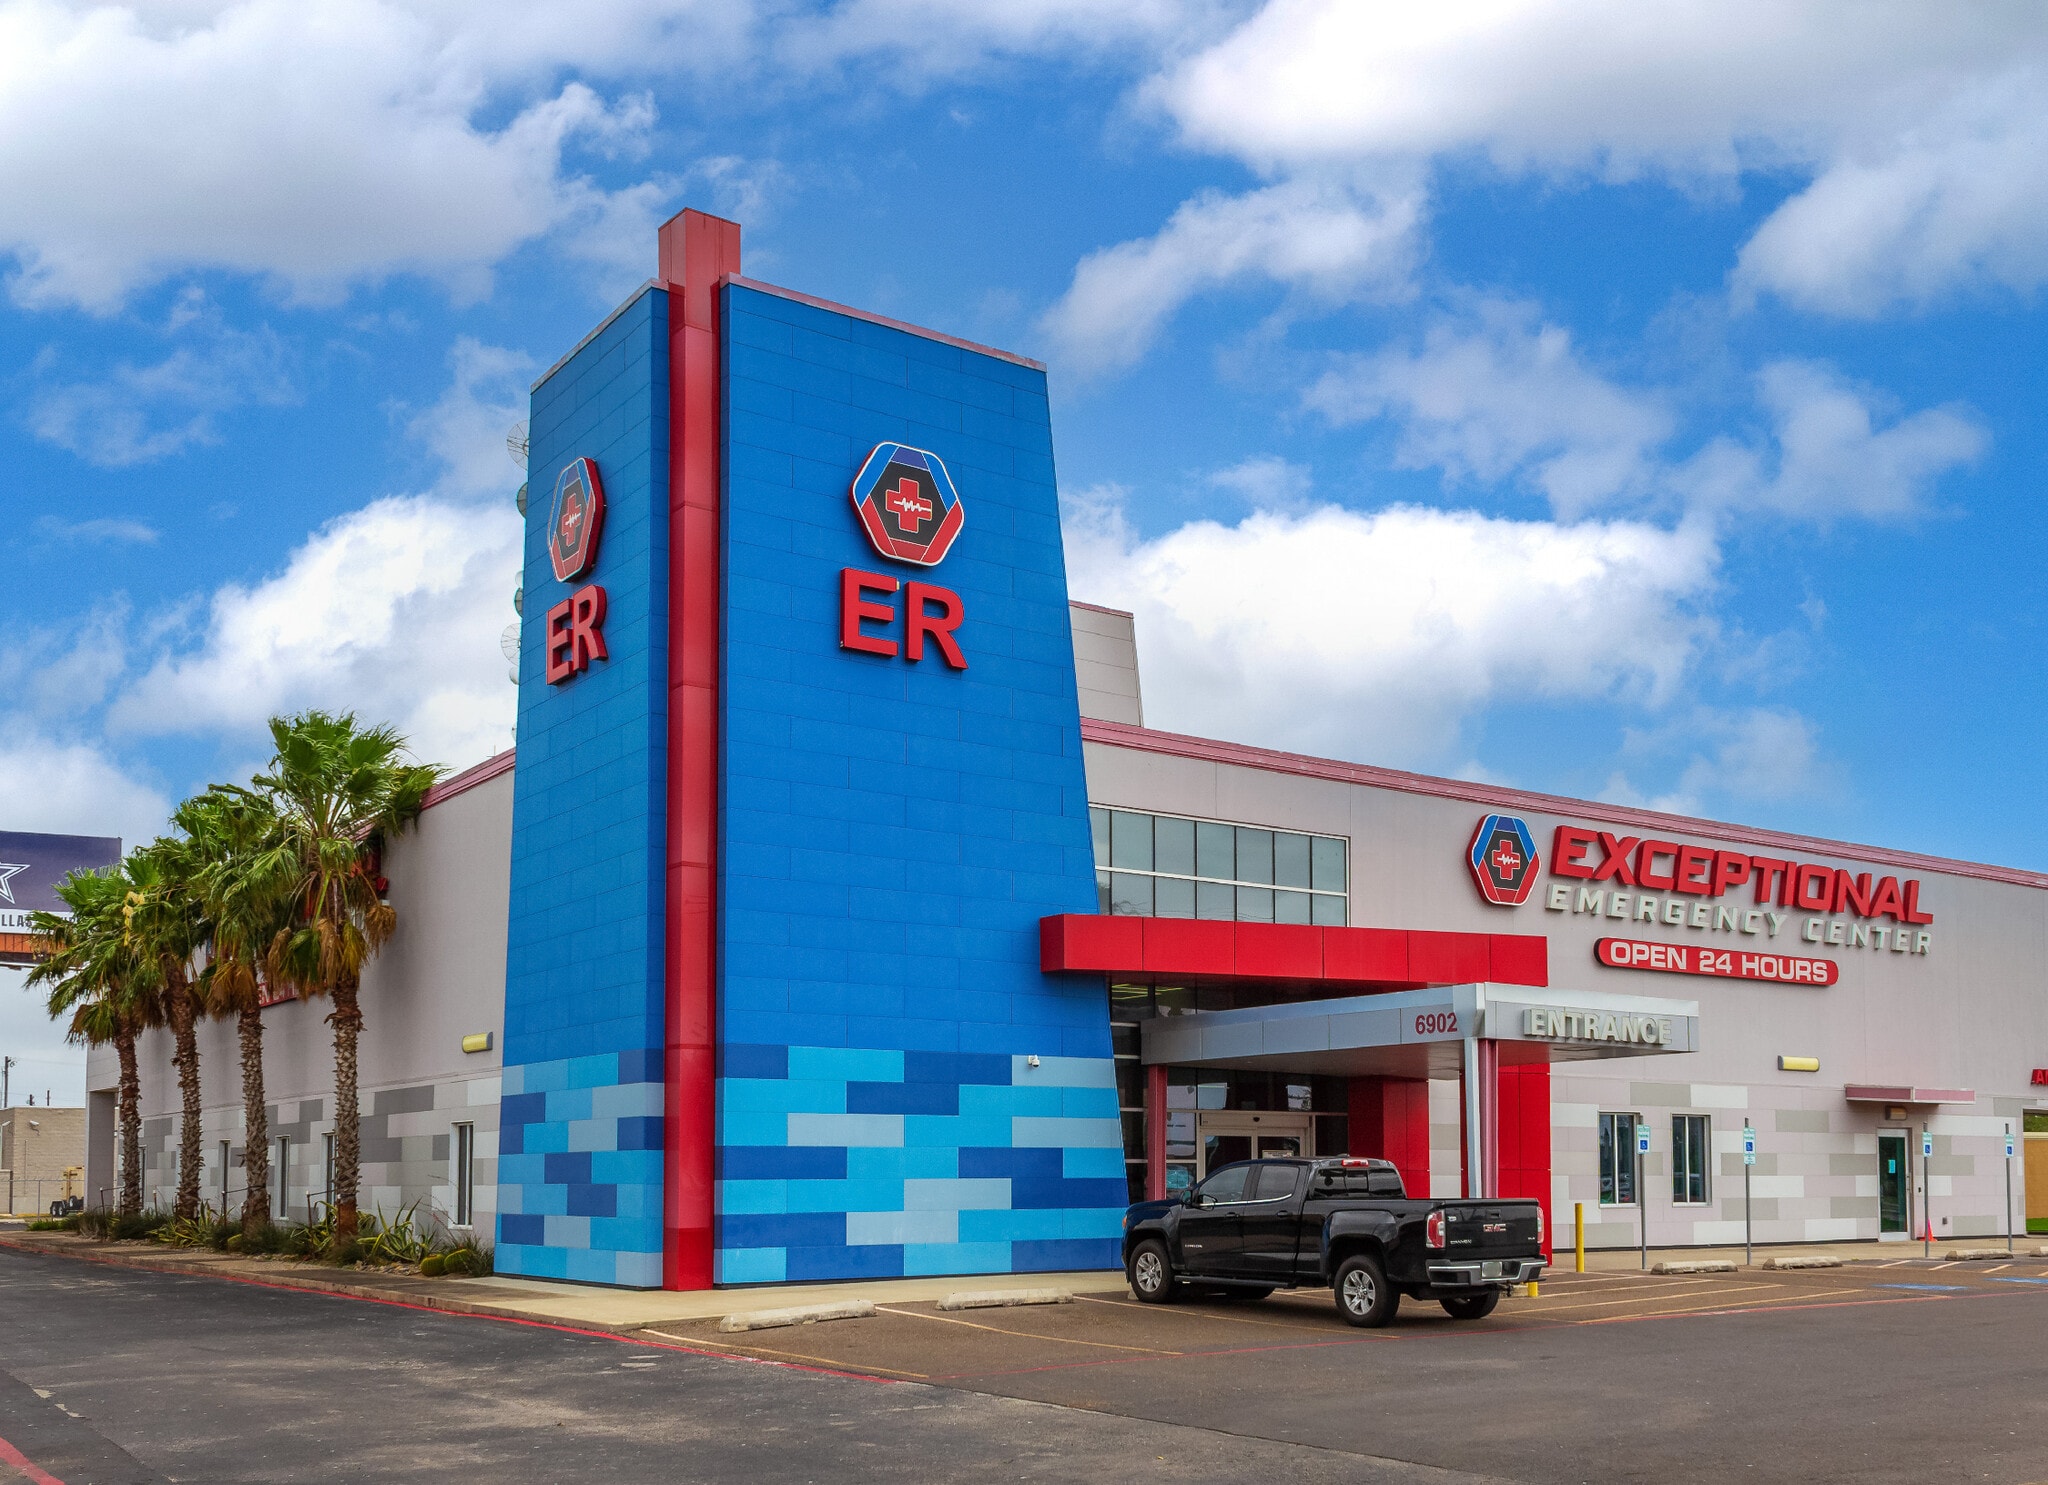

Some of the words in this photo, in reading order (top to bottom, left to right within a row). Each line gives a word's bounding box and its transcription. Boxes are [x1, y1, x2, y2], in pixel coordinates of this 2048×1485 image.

[546, 584, 608, 686] ER
[840, 568, 968, 670] ER
[1552, 825, 1934, 925] EXCEPTIONAL
[1546, 883, 1788, 936] EMERGENCY
[1801, 917, 1933, 955] CENTER
[1610, 941, 1688, 971] OPEN
[1699, 950, 1733, 974] 24
[1741, 954, 1829, 983] HOURS
[1414, 1012, 1458, 1035] 6902
[1523, 1008, 1673, 1045] ENTRANCE
